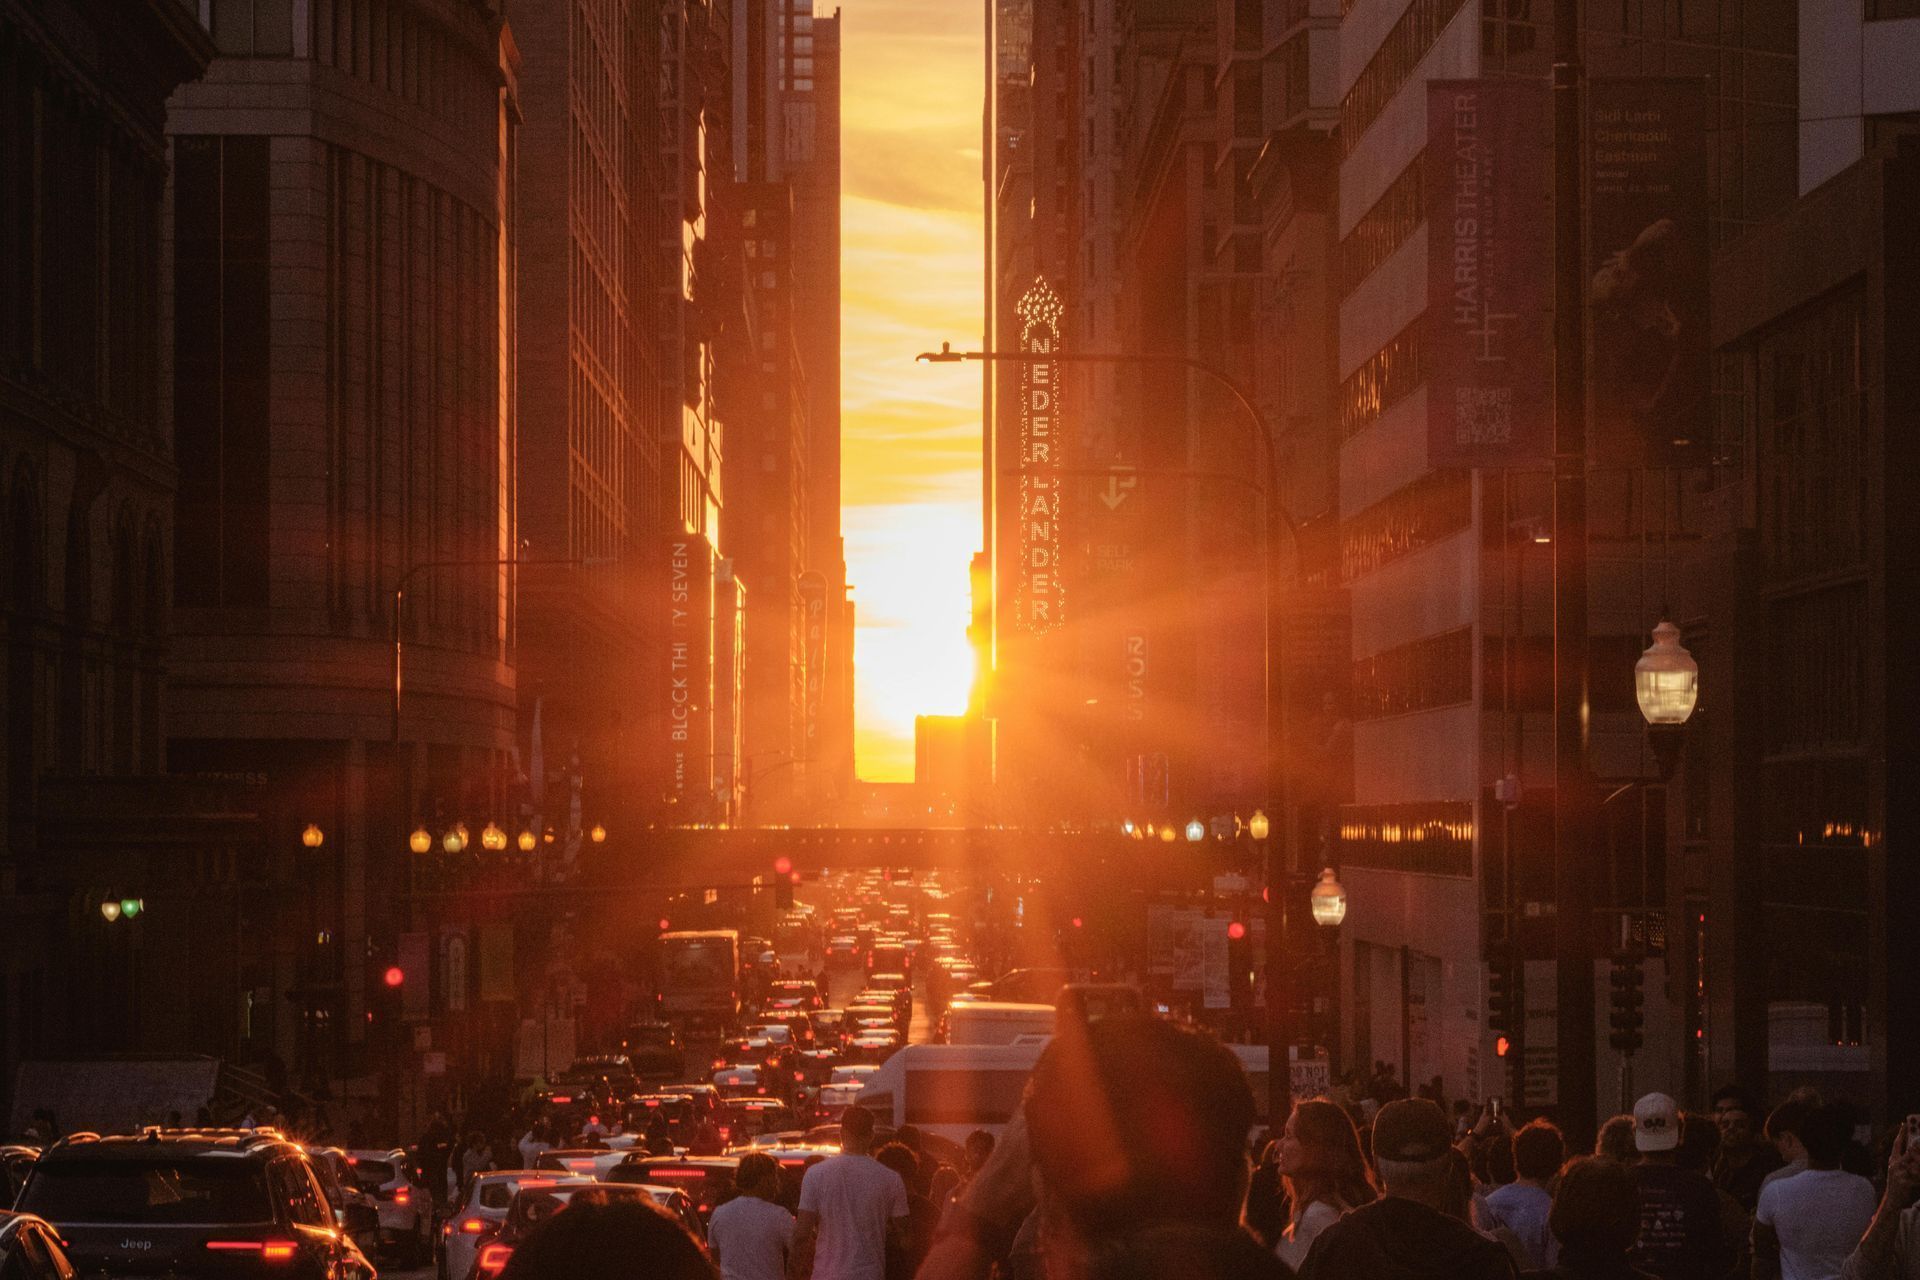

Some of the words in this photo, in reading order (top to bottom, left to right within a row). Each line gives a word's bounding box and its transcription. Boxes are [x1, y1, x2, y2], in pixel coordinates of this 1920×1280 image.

[1454, 93, 1478, 213] THEATER
[1454, 216, 1478, 325] HARRIS
[1031, 337, 1050, 621] NEDERLANDER
[672, 541, 688, 603] SEVEN
[1126, 635, 1147, 721] ROSS
[120, 1237, 152, 1251] Jeep
